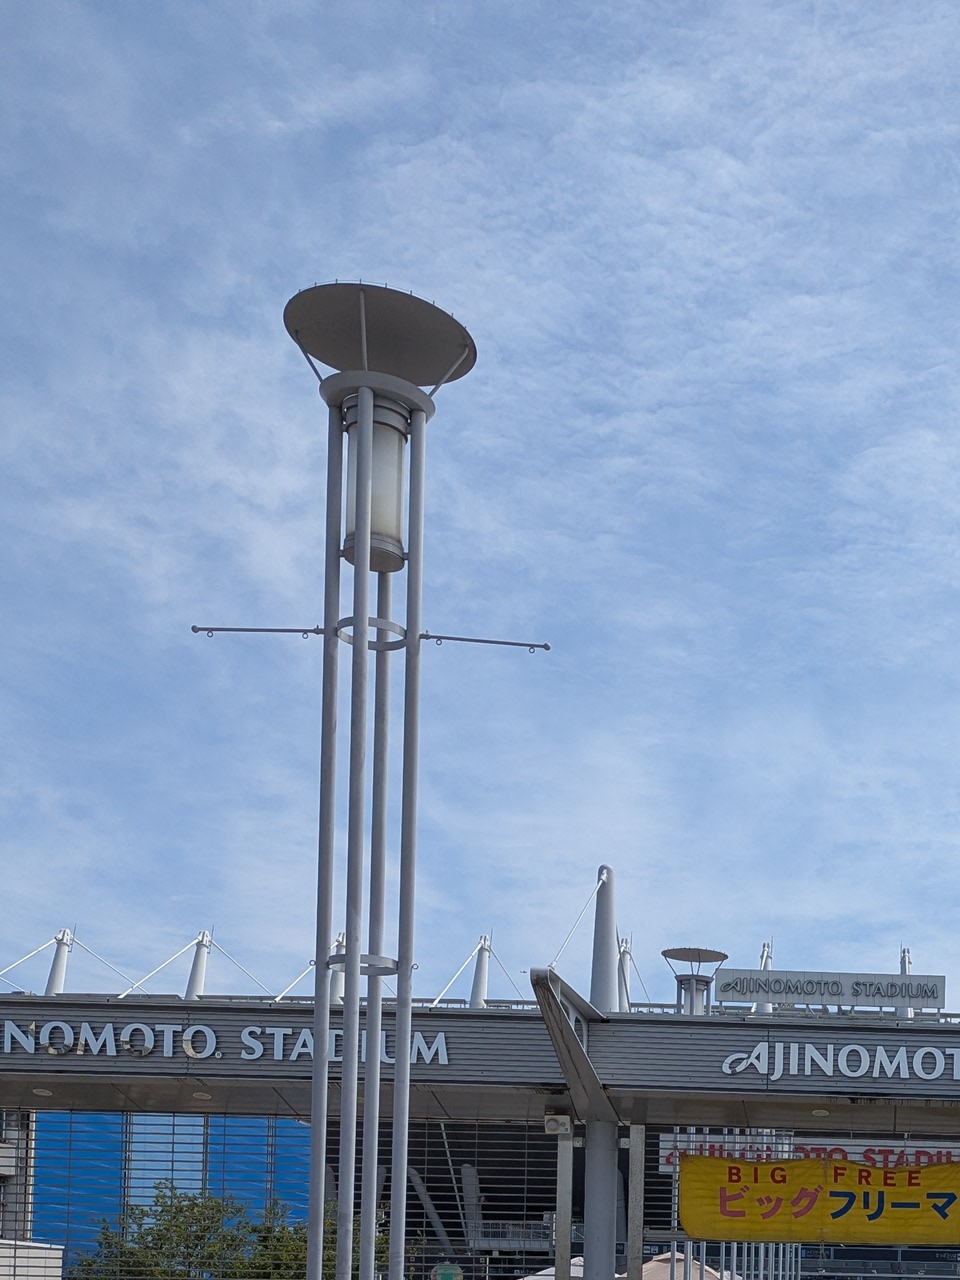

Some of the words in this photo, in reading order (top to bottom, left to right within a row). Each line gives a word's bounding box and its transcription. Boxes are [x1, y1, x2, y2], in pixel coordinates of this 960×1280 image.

[852, 980, 938, 998] STADIUM
[727, 1165, 787, 1184] BIG
[833, 1165, 922, 1187] FREE
